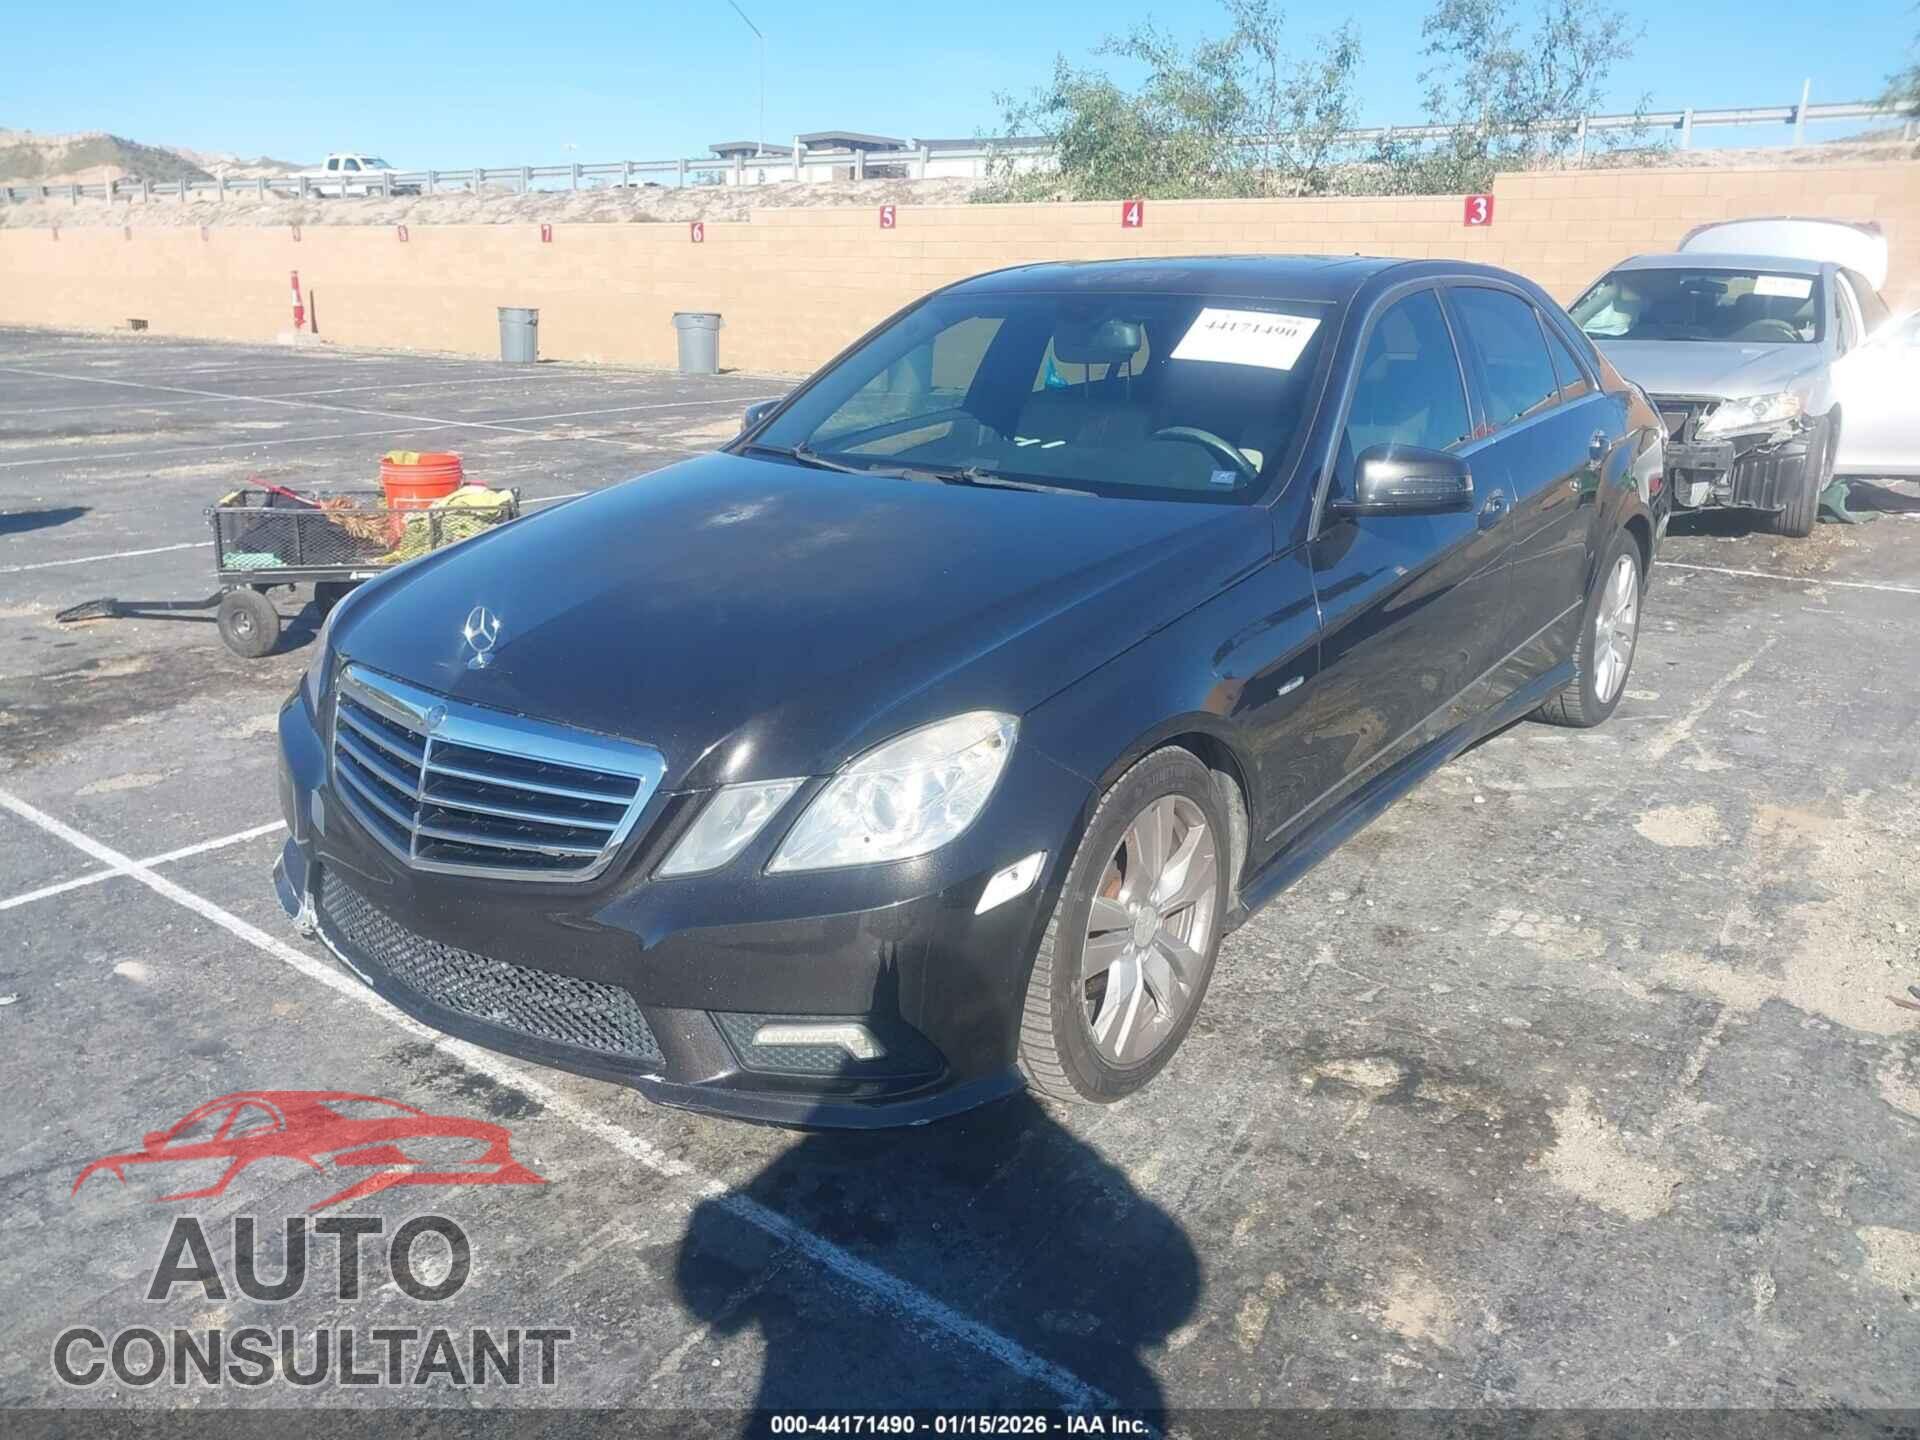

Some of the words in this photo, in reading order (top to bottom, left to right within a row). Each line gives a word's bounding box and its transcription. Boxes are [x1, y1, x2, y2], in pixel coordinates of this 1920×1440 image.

[883, 207, 893, 228] 5
[1126, 202, 1140, 226] 4
[1470, 198, 1488, 224] 3
[693, 223, 702, 242] 6
[1204, 319, 1299, 337] 44171490
